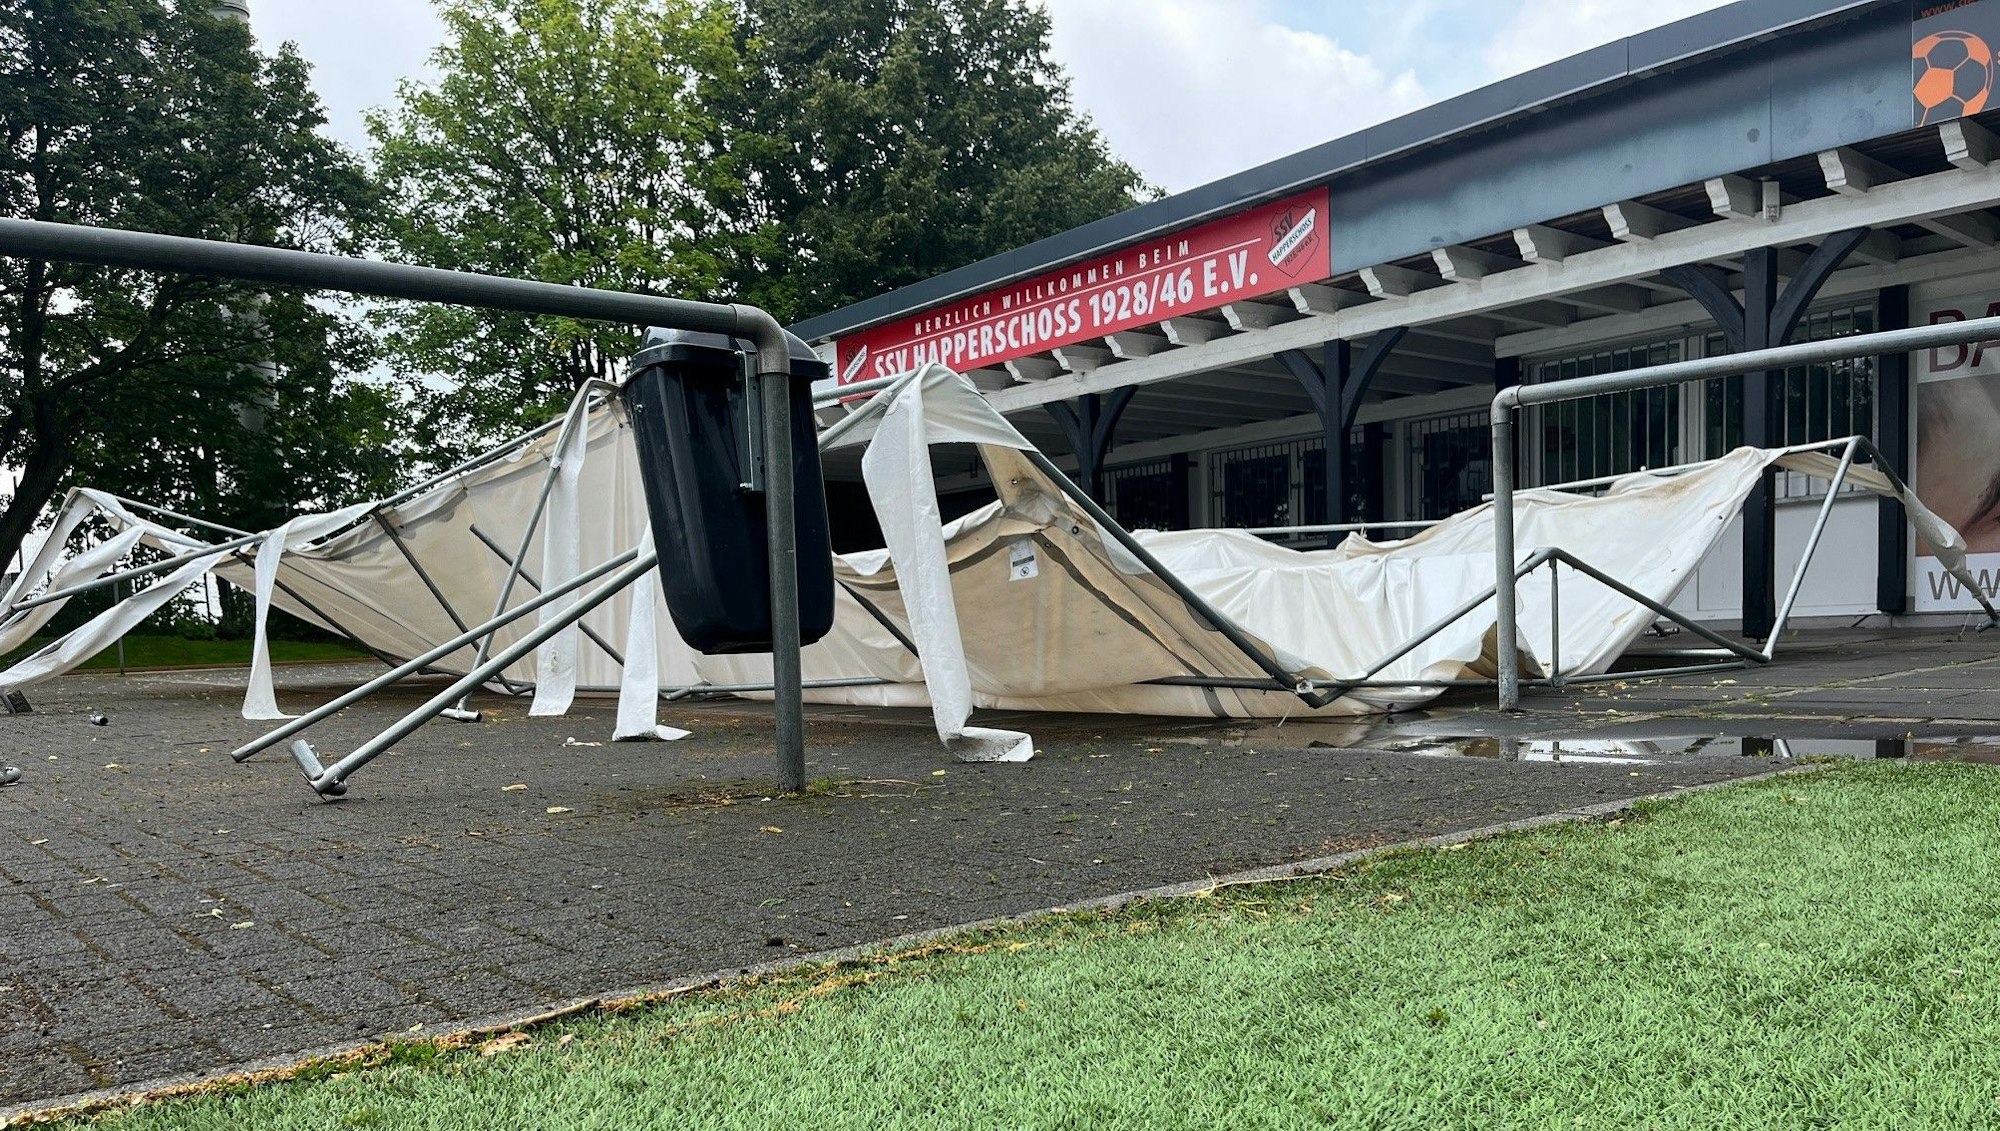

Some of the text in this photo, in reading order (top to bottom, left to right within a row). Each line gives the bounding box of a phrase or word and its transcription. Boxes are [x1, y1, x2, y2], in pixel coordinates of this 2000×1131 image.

[1272, 217, 1312, 262] HAPPERSCHOSS
[1274, 211, 1294, 242] SSV
[875, 349, 908, 378] SSV
[914, 299, 1082, 370] HAPPERSCHOSS
[1089, 267, 1194, 327] 1928/46
[1204, 250, 1258, 298] E.V.
[915, 240, 1188, 335] HERZLICH WILLKOMMEN BEIM
